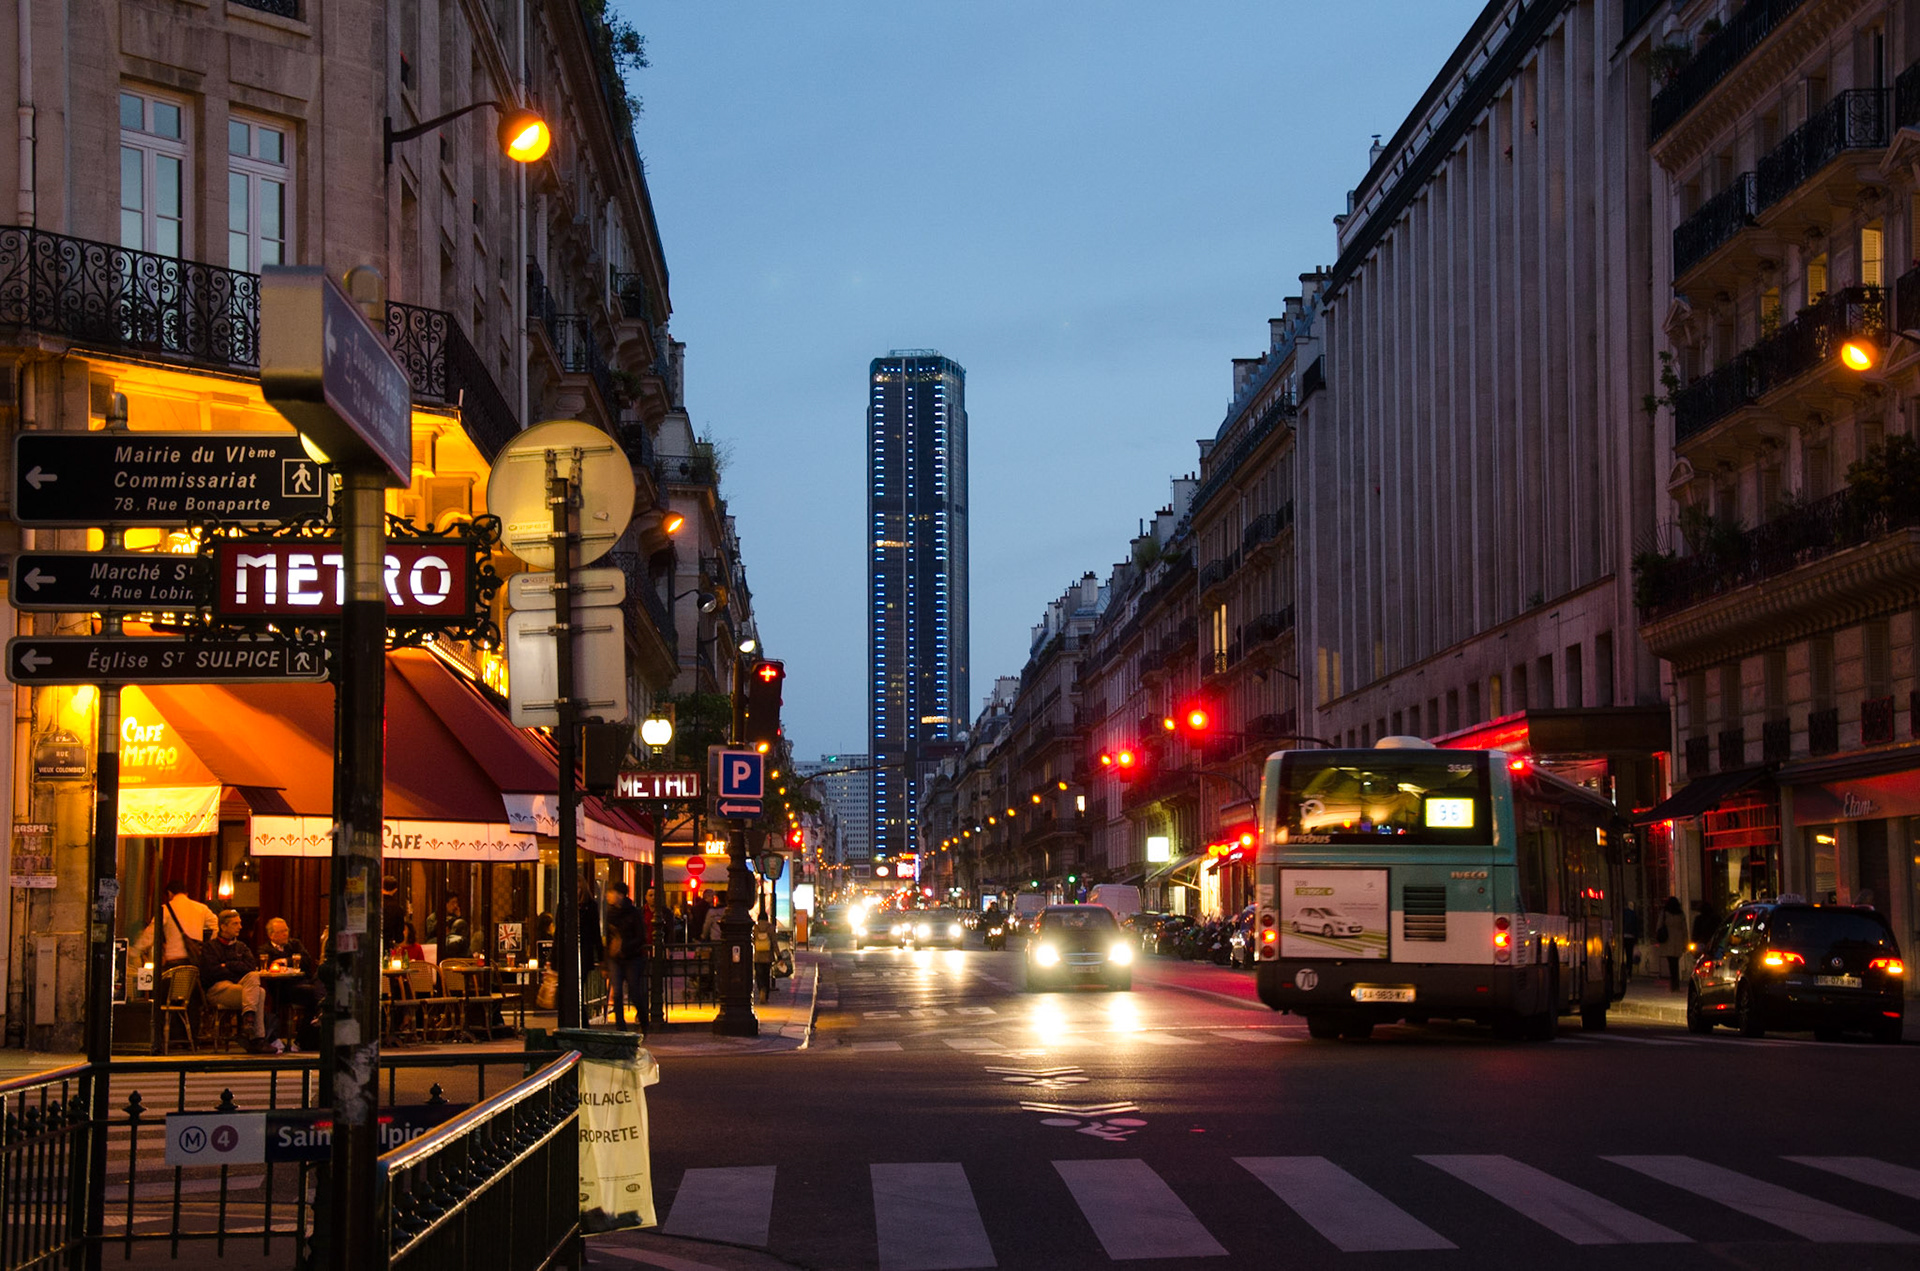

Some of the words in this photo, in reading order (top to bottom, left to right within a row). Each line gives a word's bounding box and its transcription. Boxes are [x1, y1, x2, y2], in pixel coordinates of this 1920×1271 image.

[114, 446, 181, 463] Mairie
[191, 446, 214, 463] du
[114, 471, 257, 489] Commissariat
[147, 498, 177, 511] Rue
[185, 498, 271, 514] Bonaparte
[90, 563, 161, 580] Marché
[235, 553, 451, 606] METRO
[111, 585, 143, 599] Rue
[87, 648, 149, 672] Église
[196, 651, 280, 668] SULPICE
[733, 760, 751, 789] P
[617, 773, 697, 797] METRO
[1843, 792, 1871, 817] Etam
[14, 824, 49, 833] GOSPEL
[1450, 871, 1488, 880] IVECO
[1300, 970, 1315, 988] 70
[217, 1131, 229, 1146] 4
[579, 1125, 639, 1143] ROPRETE
